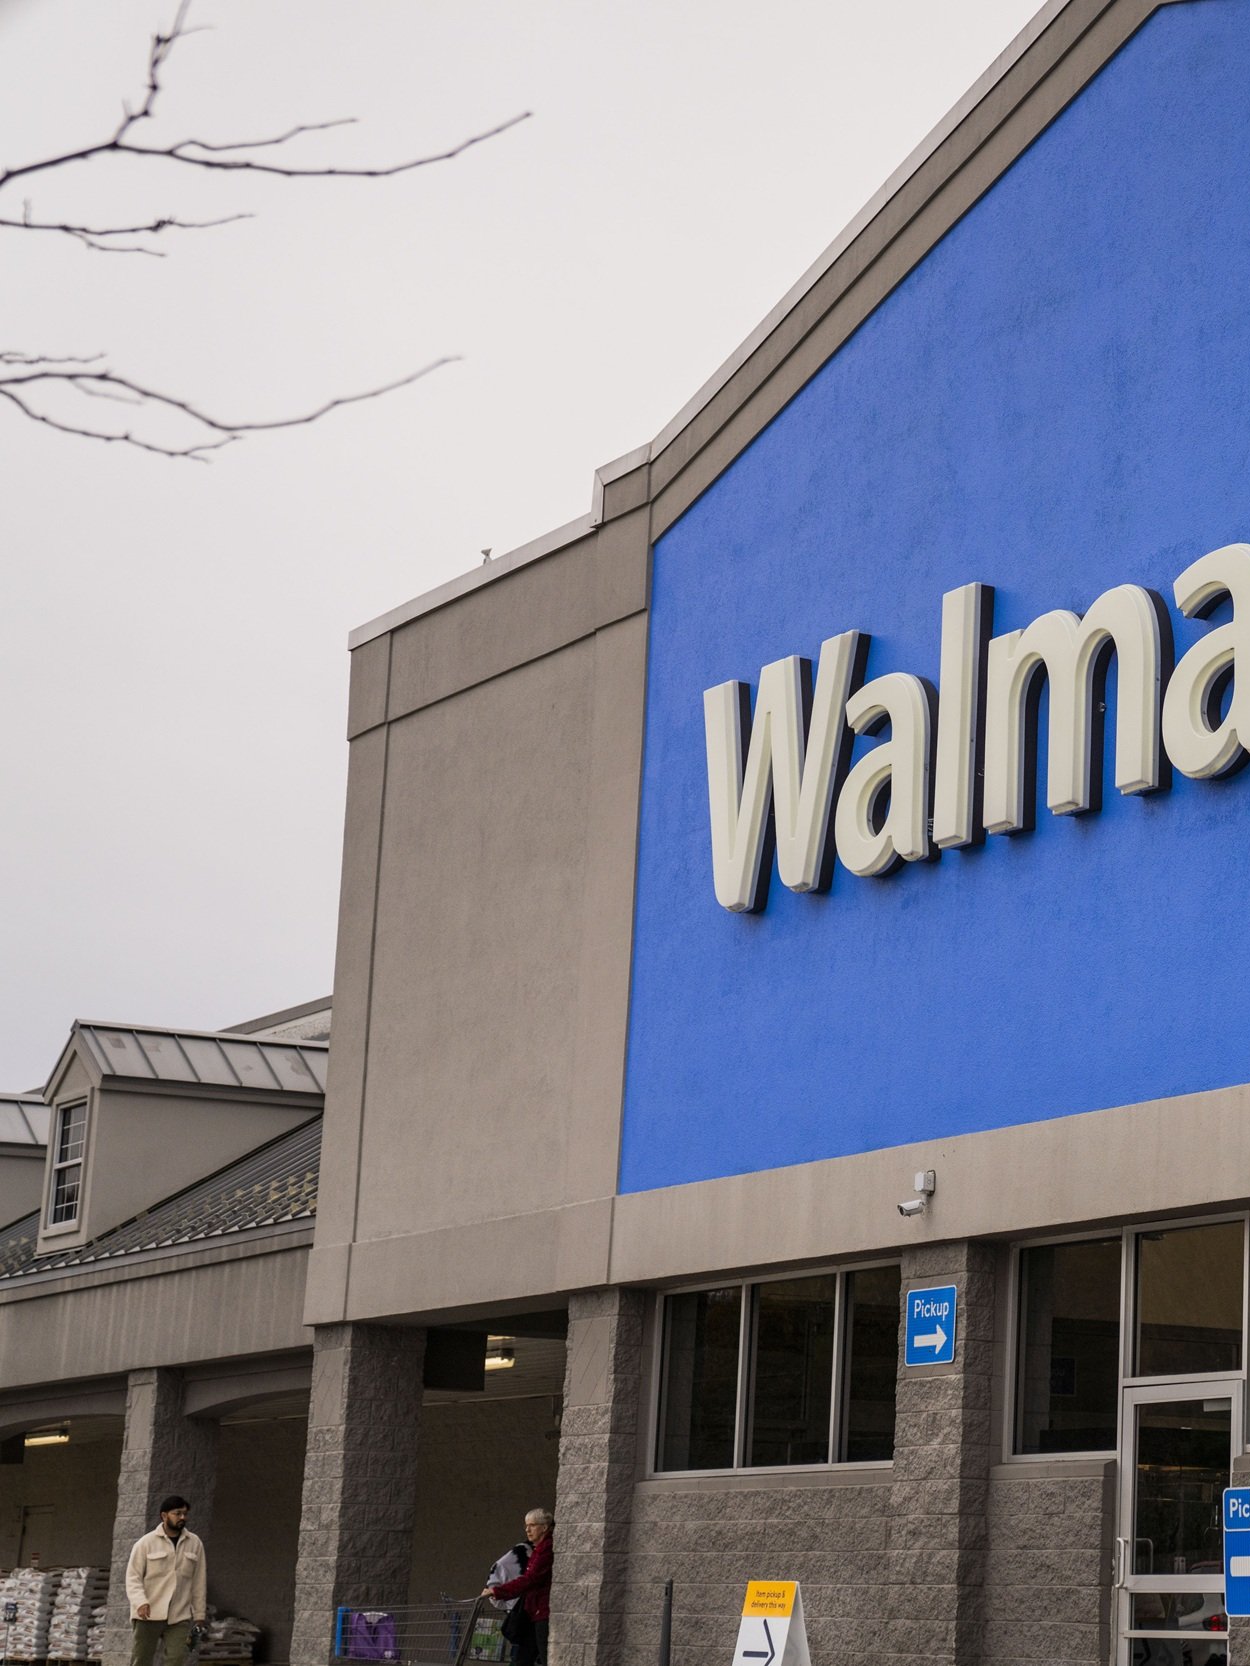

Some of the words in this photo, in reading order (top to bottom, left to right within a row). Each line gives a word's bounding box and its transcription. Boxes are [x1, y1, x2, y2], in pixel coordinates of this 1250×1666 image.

[914, 1299, 949, 1321] Pickup
[766, 1590, 781, 1600] pickup
[751, 1601, 768, 1609] delivery
